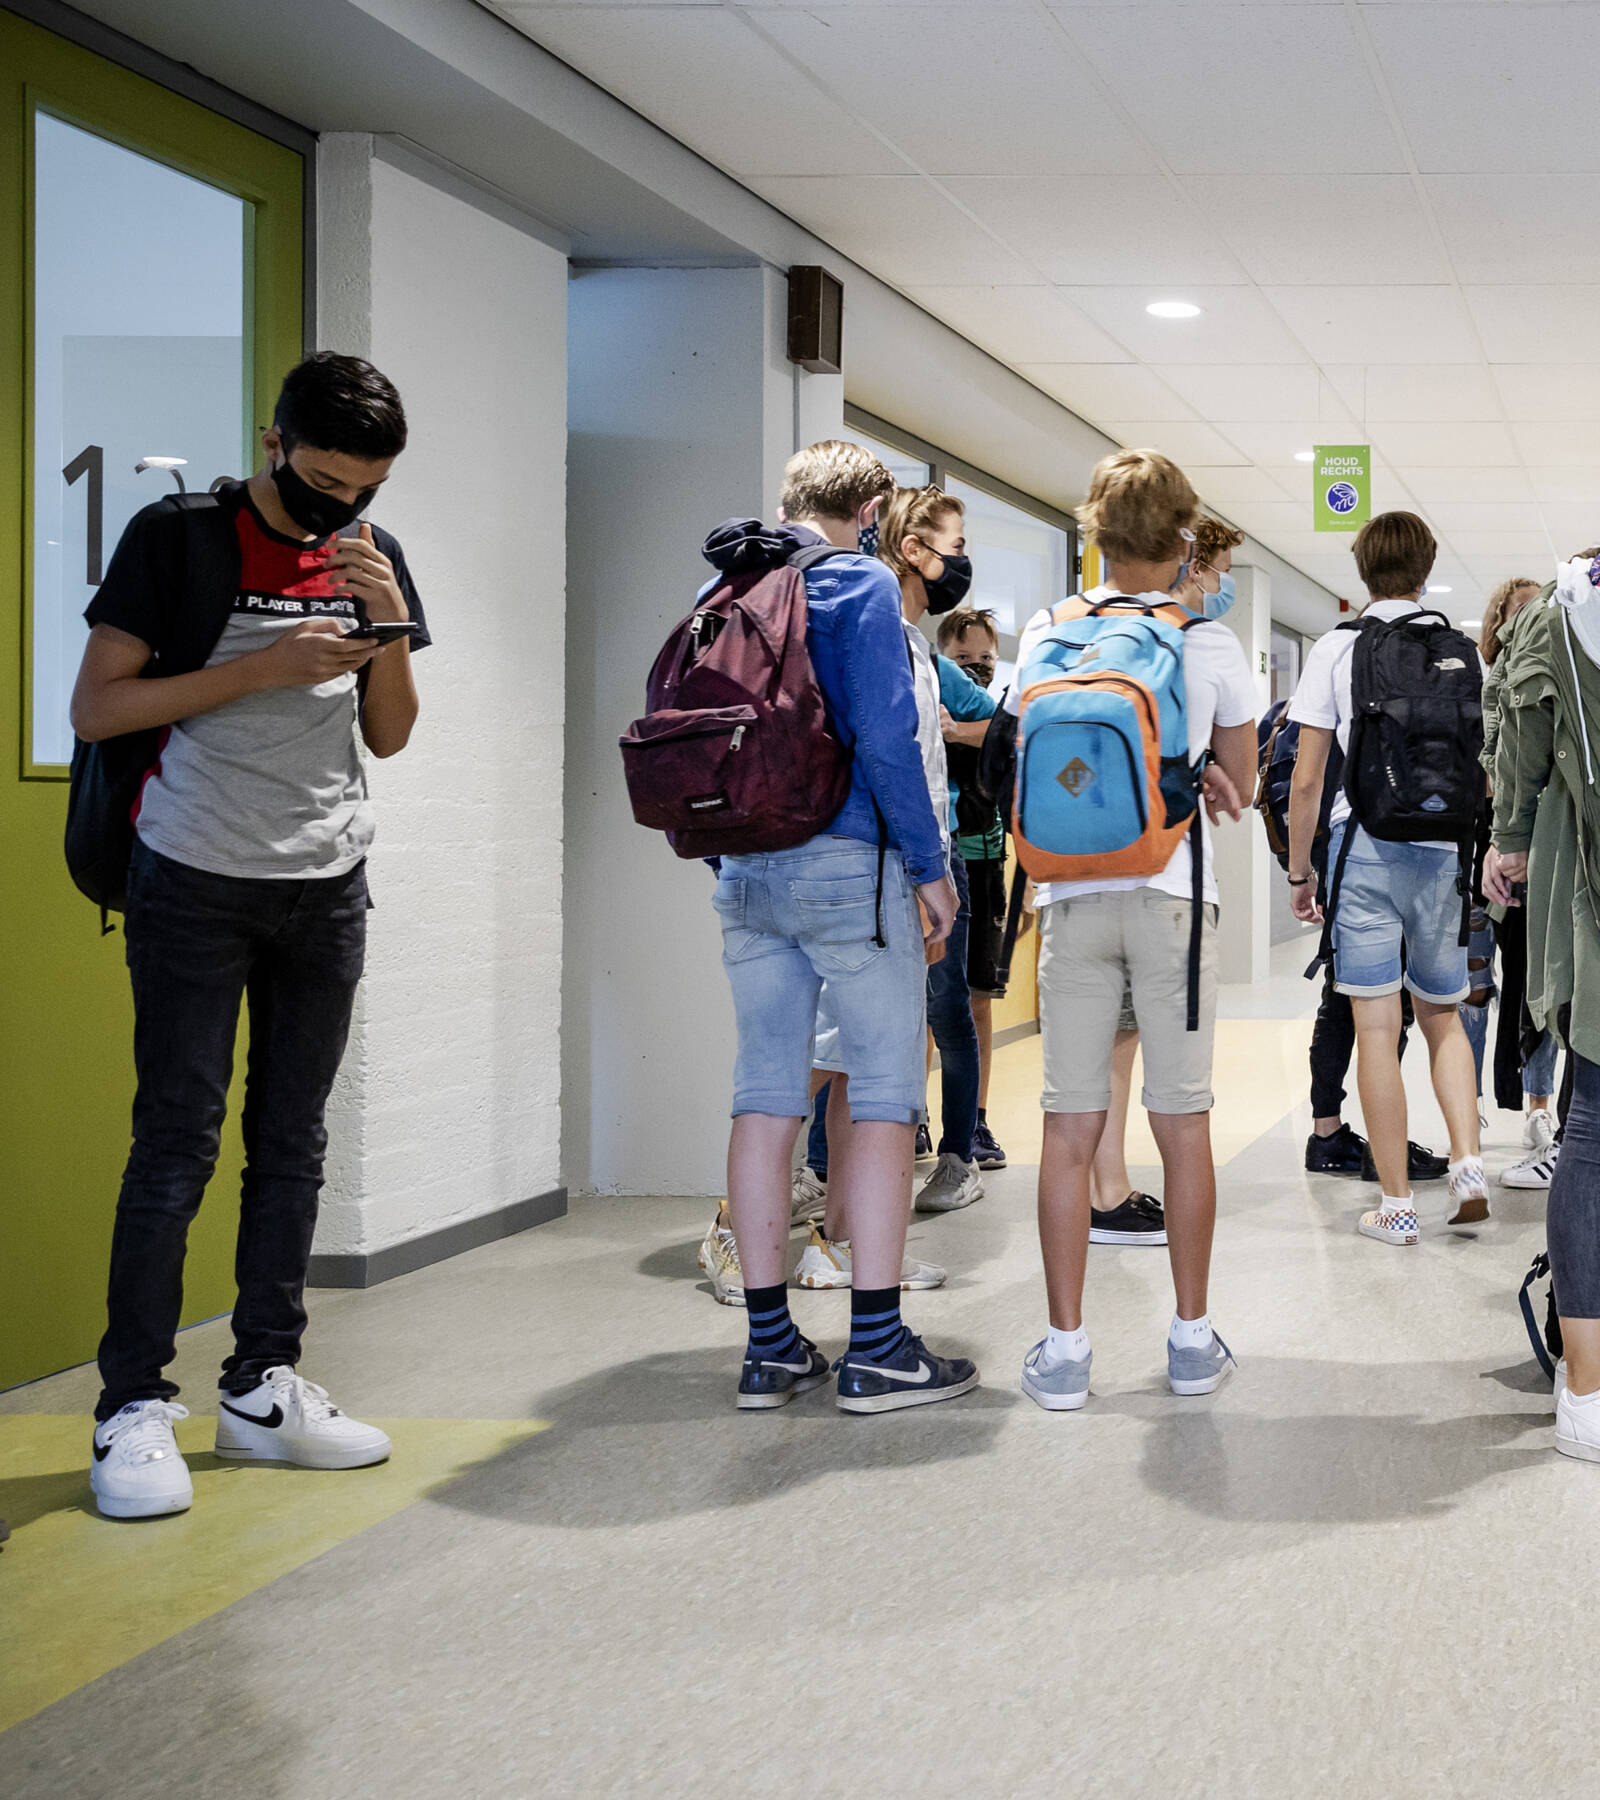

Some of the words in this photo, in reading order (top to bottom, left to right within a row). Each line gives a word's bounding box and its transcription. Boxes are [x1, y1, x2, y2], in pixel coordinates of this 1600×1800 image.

[1325, 456, 1359, 466] HOUD
[1320, 466, 1364, 476] RECHTS
[247, 595, 304, 612] PLAYER
